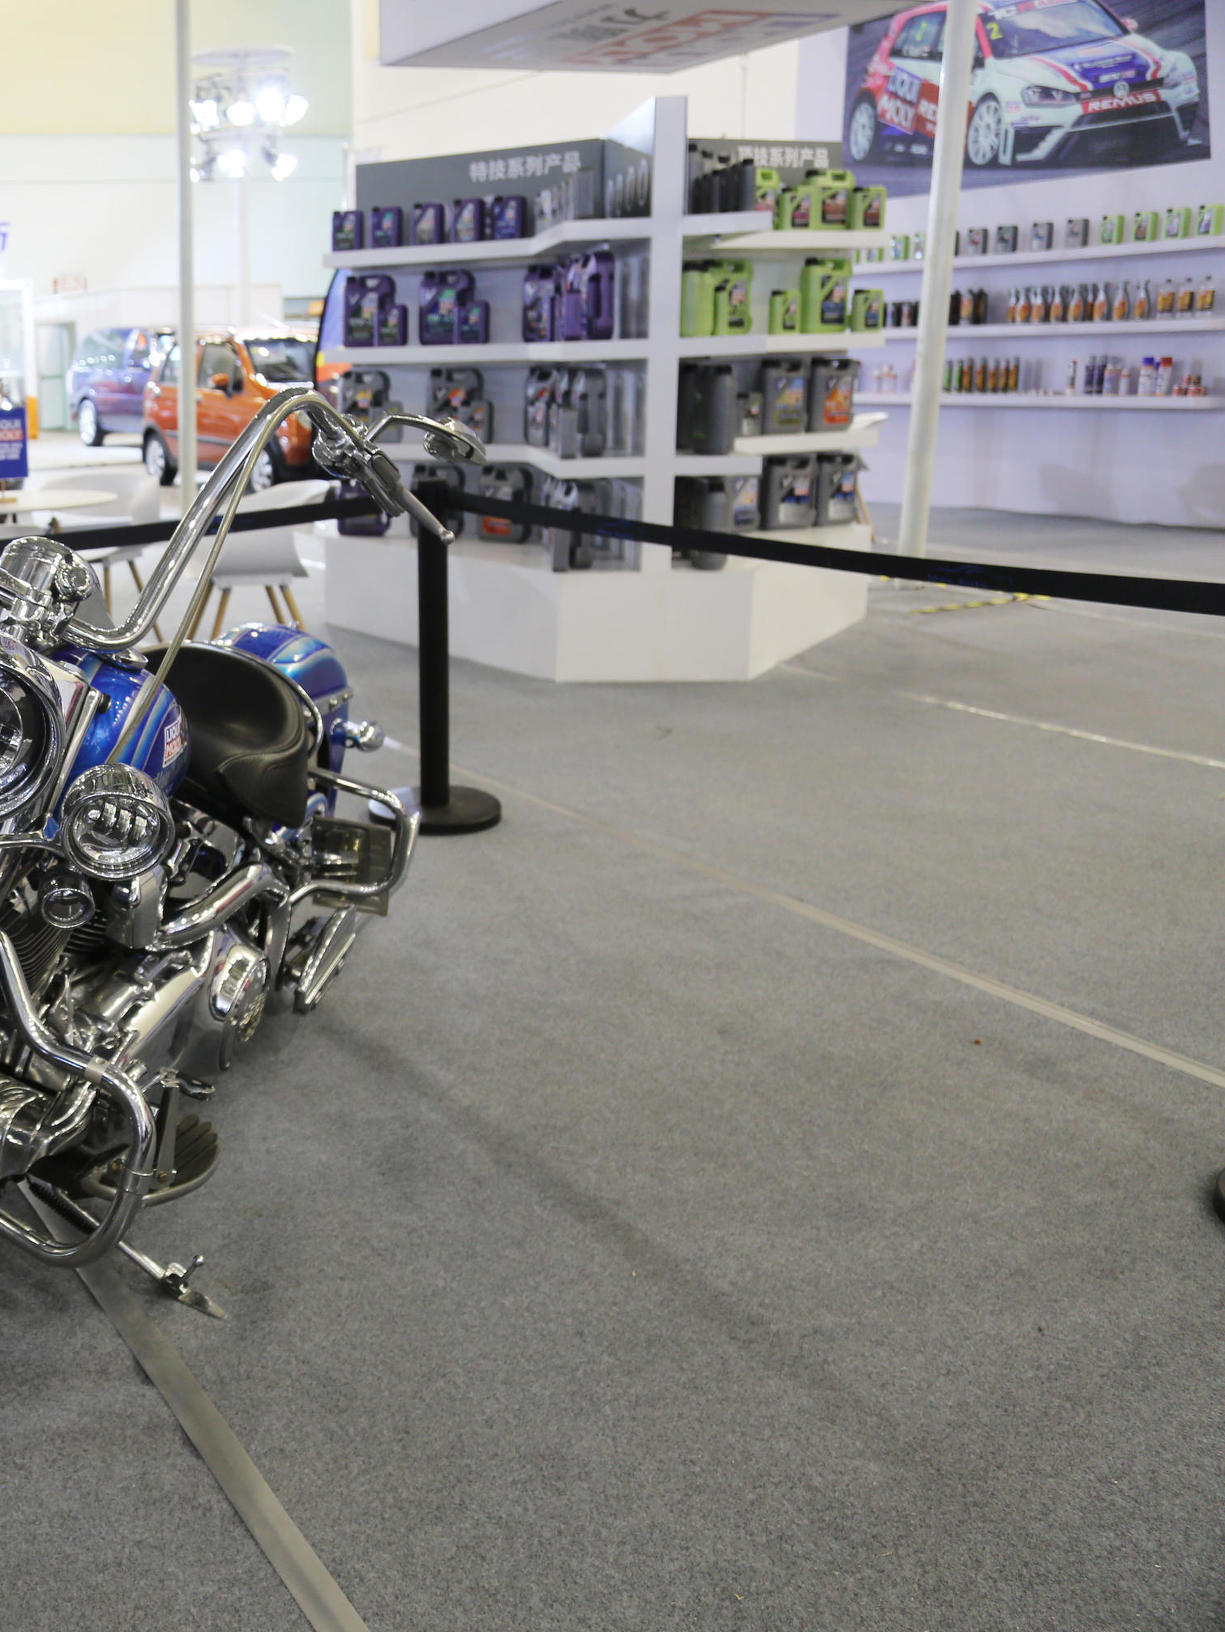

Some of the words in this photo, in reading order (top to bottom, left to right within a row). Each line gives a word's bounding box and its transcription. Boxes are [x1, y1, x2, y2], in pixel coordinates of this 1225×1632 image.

[986, 21, 1003, 40] 2
[1087, 91, 1157, 112] REMUS
[469, 150, 581, 182] 特技系列产品
